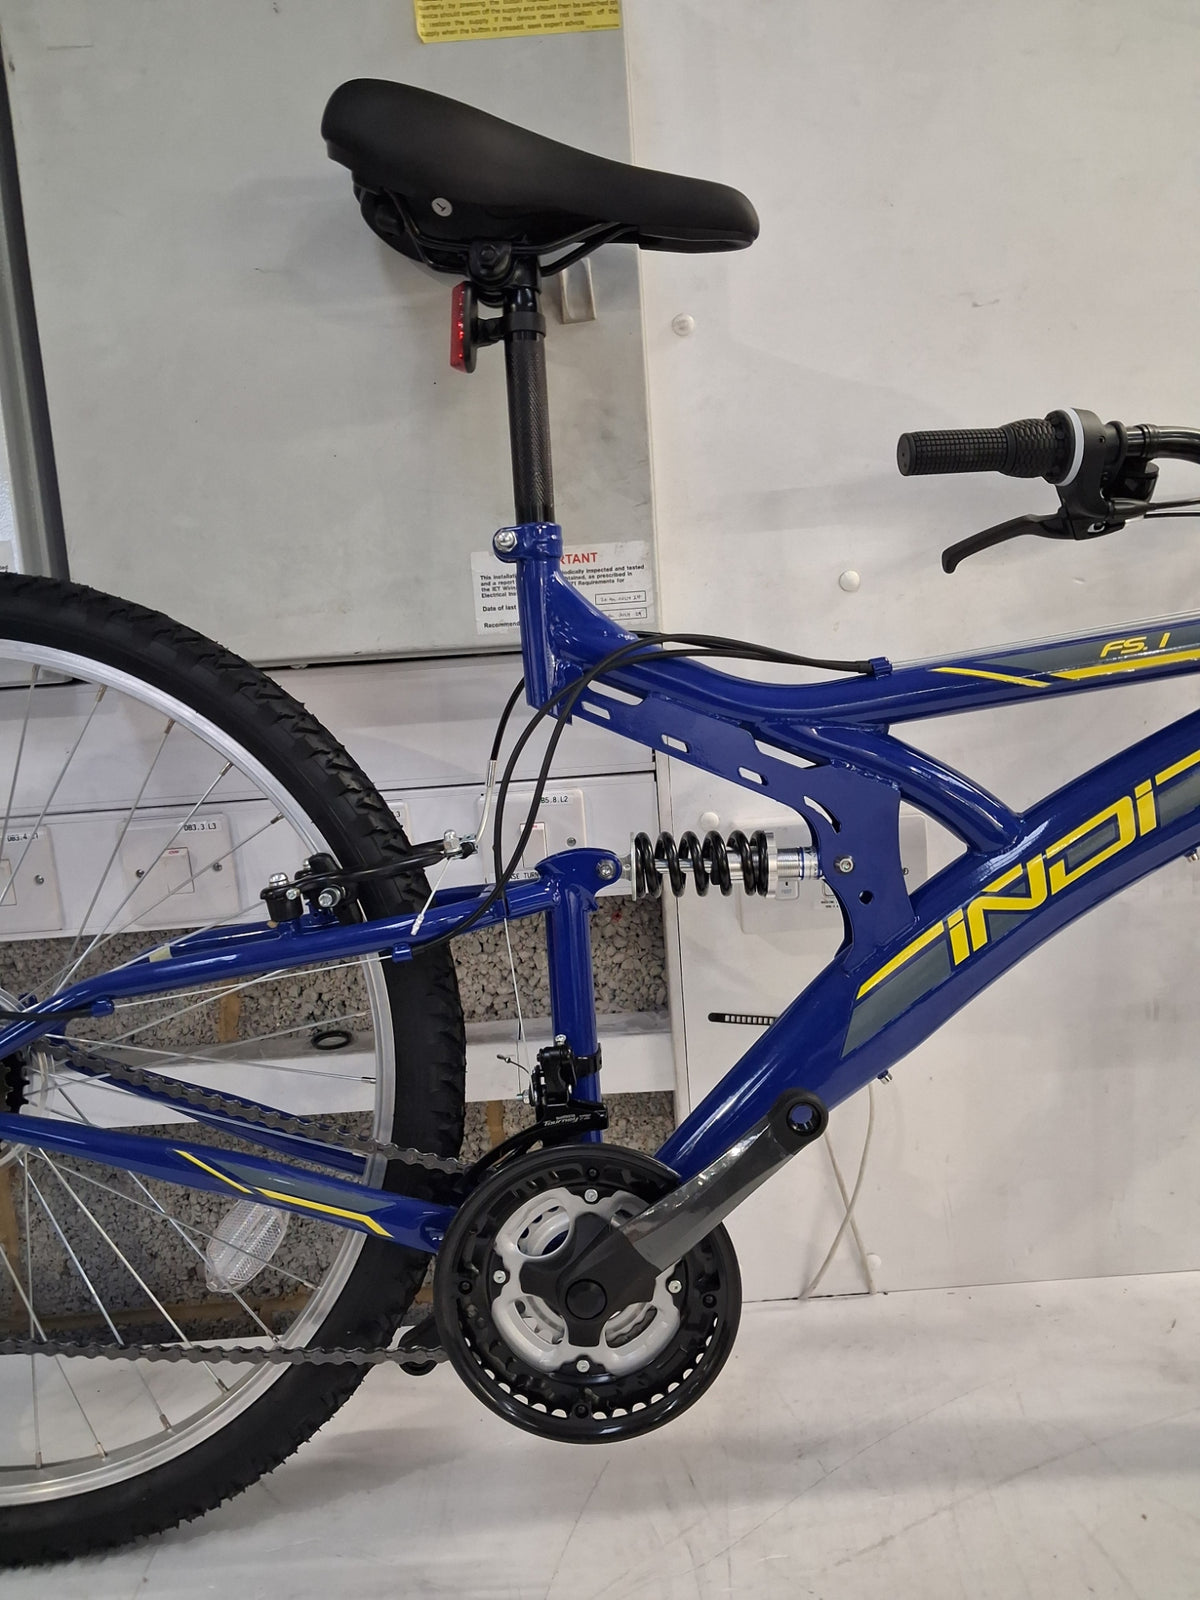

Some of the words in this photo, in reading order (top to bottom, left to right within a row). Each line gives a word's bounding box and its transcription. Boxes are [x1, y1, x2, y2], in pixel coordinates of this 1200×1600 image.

[586, 566, 613, 574] inspected
[596, 572, 626, 580] prescribed
[207, 822, 217, 830] L3
